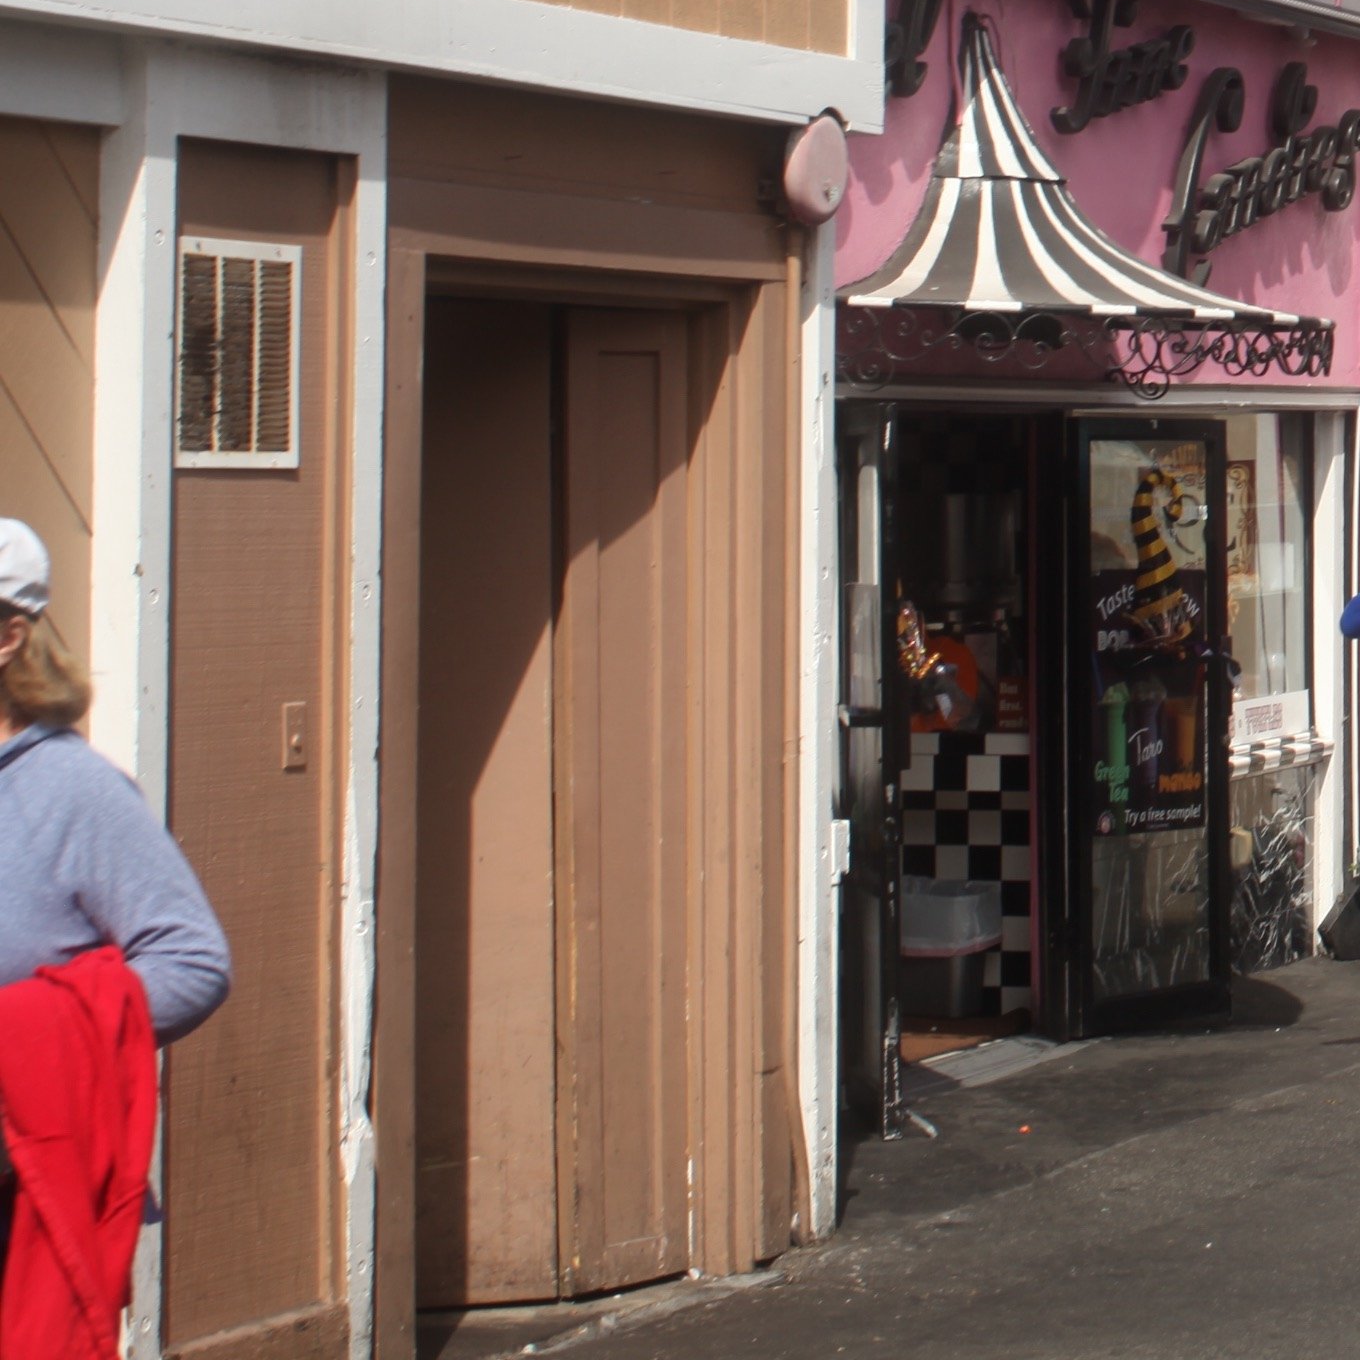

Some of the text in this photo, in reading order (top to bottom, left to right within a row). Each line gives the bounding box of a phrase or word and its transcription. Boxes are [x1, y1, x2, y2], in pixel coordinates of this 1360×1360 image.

[1096, 584, 1137, 621] Taste
[1127, 726, 1164, 766] Taro
[1093, 760, 1131, 783] Green
[1108, 782, 1130, 804] Tea
[1124, 803, 1202, 827] Try a free sample!
